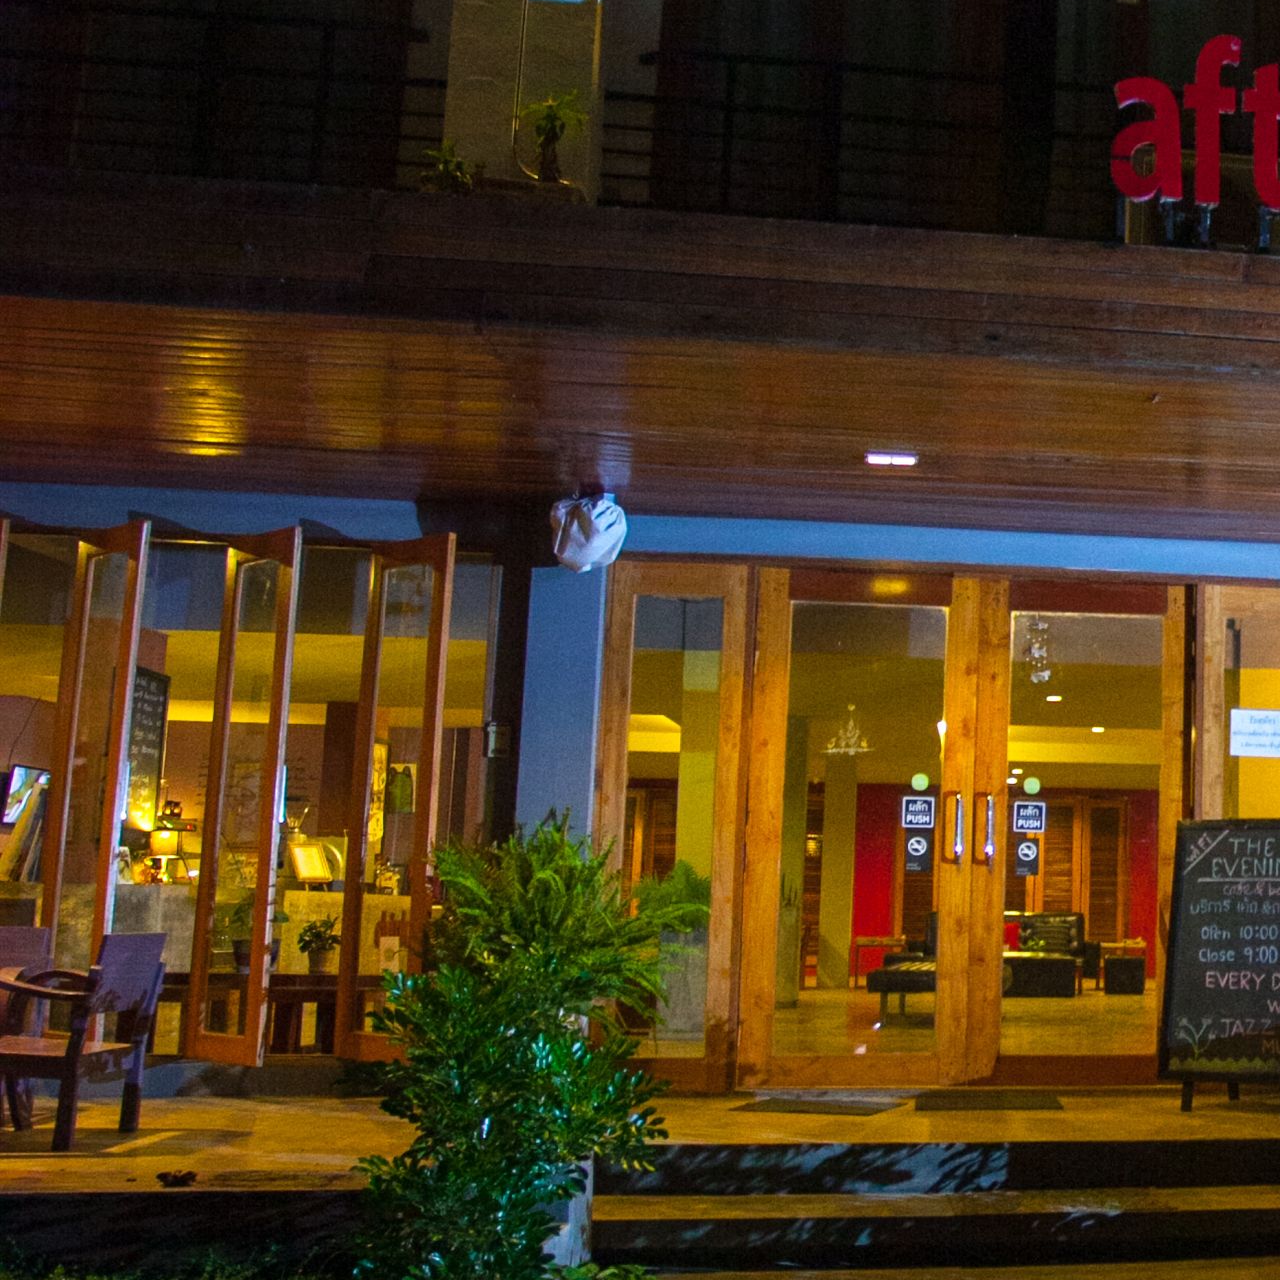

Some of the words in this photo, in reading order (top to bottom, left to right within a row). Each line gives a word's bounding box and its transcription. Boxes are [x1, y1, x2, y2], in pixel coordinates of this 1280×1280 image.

[906, 814, 930, 824] PUSH
[1017, 819, 1041, 829] PUSH
[1228, 838, 1276, 857] THE
[1239, 924, 1279, 940] 10:00
[1199, 947, 1236, 963] Close
[1243, 945, 1279, 964] 9:00
[1205, 970, 1266, 991] EVERY
[1219, 1018, 1275, 1039] JAZZ
